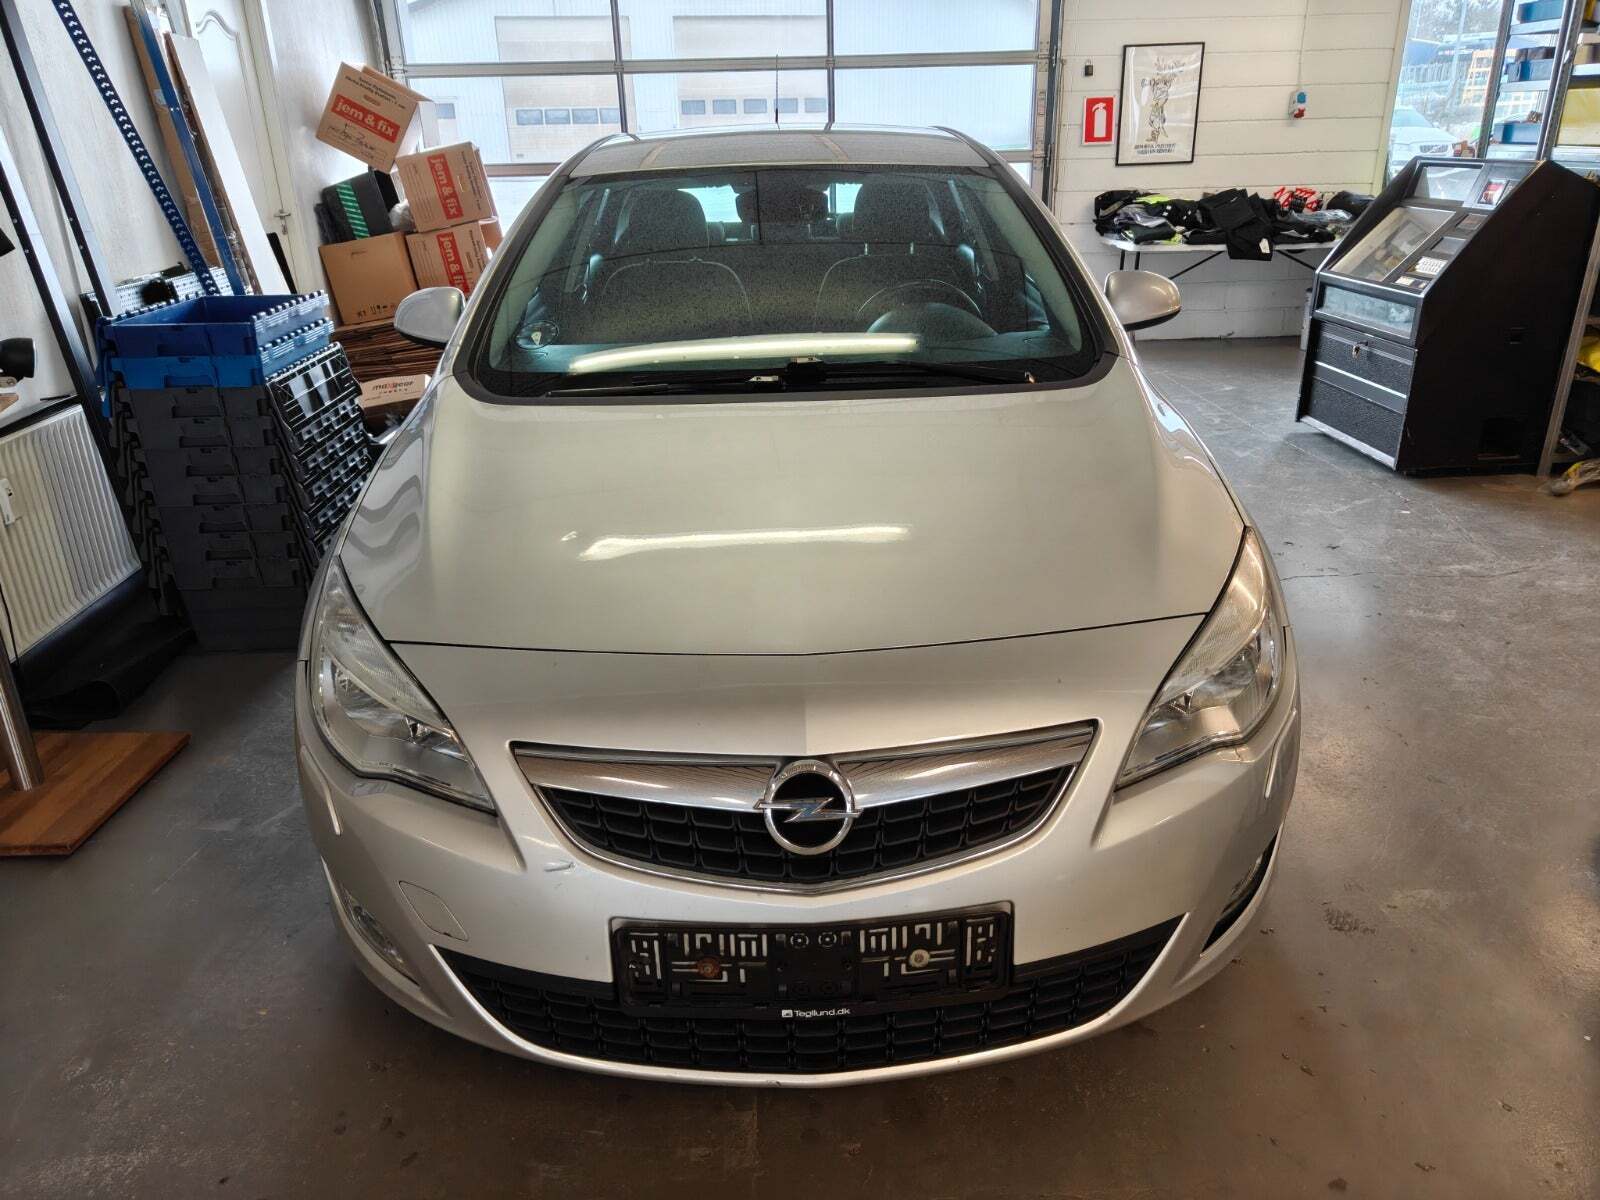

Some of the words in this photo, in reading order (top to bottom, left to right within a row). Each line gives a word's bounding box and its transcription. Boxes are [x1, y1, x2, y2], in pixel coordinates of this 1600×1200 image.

[336, 99, 364, 119] jem
[365, 114, 375, 126] &
[377, 120, 394, 137] fix
[430, 157, 447, 184] jem
[442, 186, 454, 196] &
[445, 198, 459, 216] fix
[440, 236, 455, 262] jem
[450, 264, 459, 273] &
